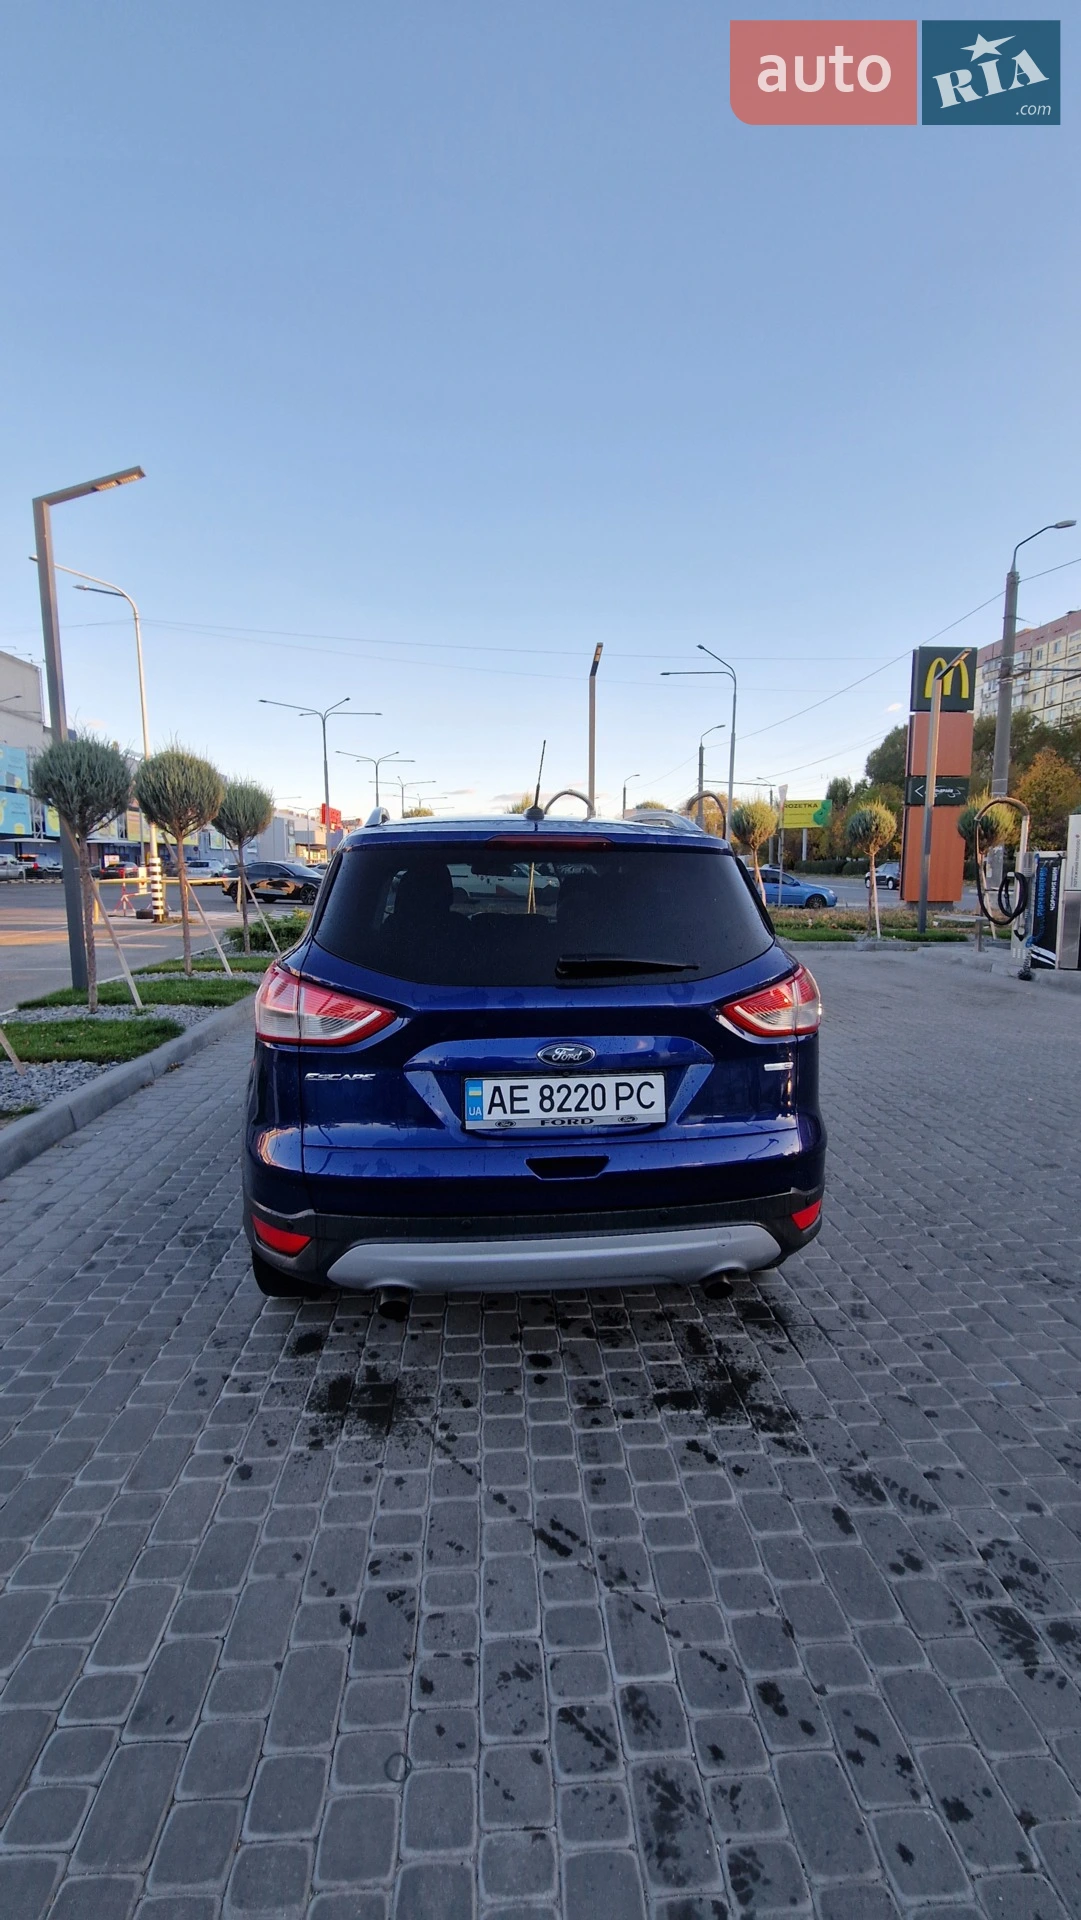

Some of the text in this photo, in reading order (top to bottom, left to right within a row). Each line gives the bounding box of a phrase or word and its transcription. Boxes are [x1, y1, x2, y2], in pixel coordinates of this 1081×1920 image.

[552, 1047, 582, 1061] Ford
[487, 1081, 656, 1115] AE 8220 PC
[468, 1106, 482, 1116] UA
[540, 1117, 594, 1126] FORD
